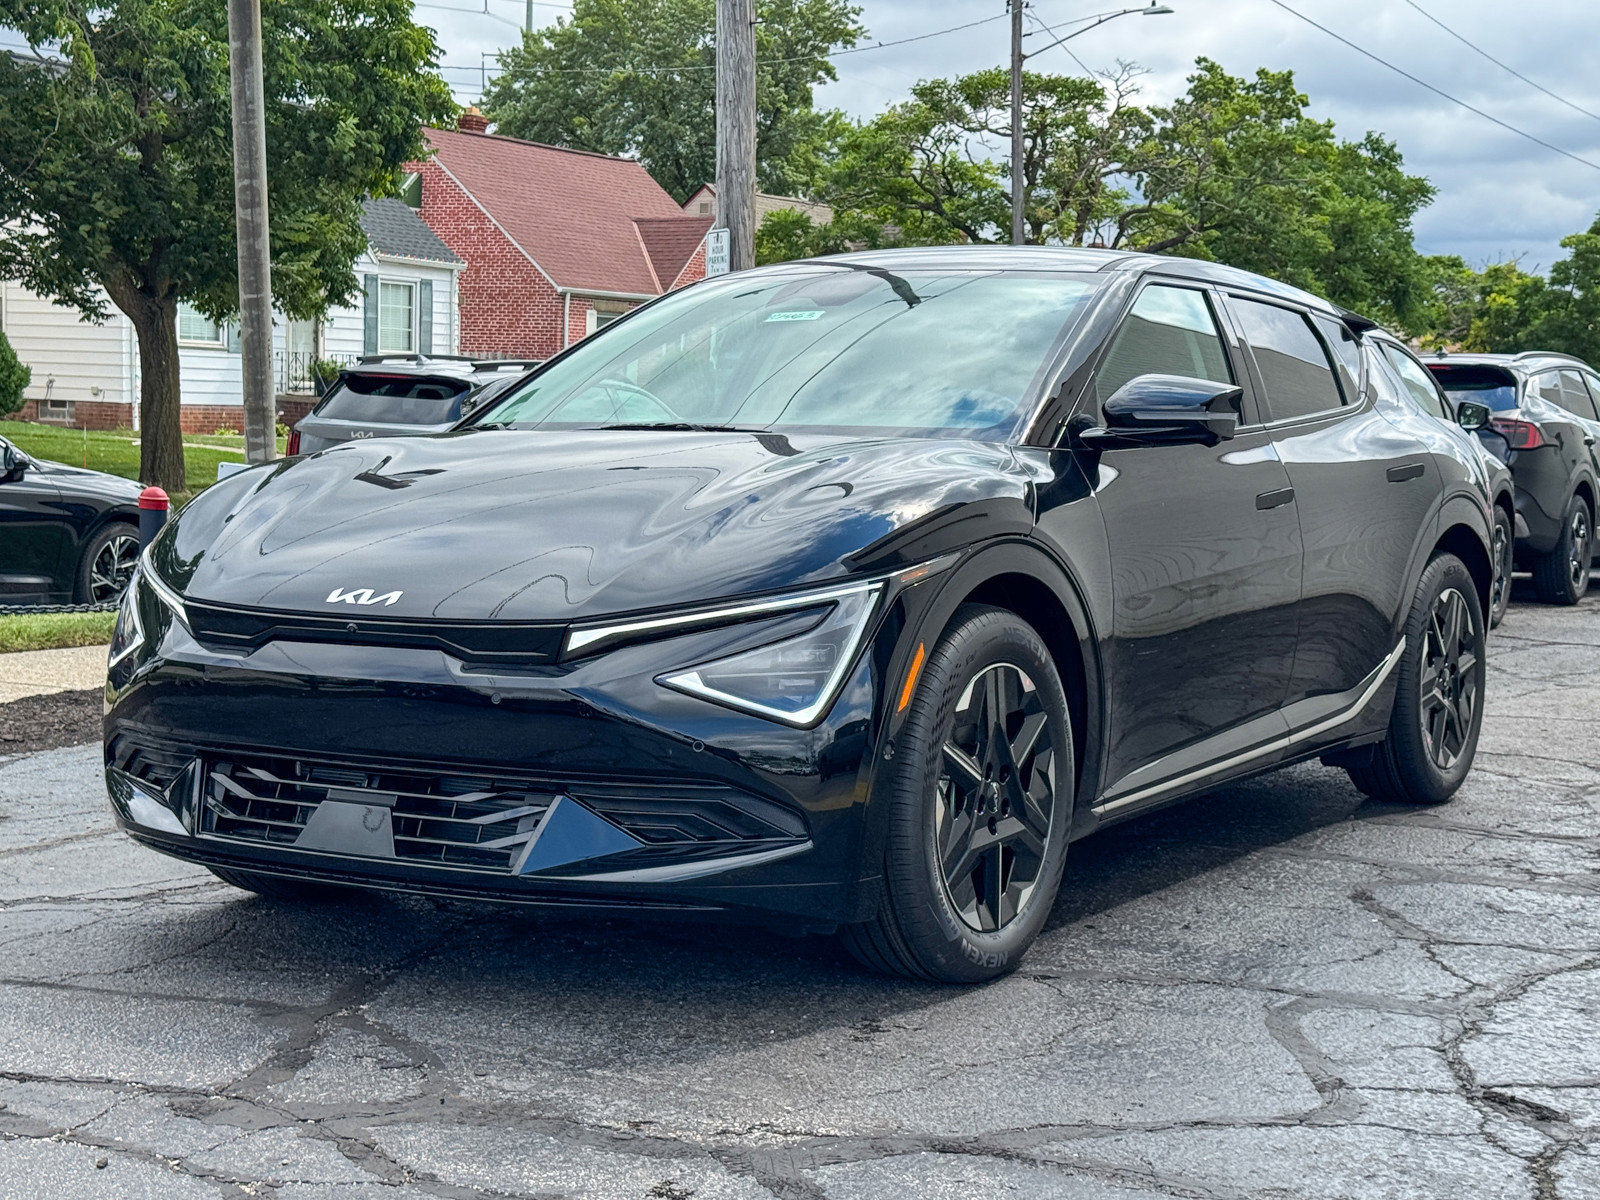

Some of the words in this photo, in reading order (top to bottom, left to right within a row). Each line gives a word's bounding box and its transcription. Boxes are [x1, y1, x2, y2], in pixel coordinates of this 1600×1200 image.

[708, 255, 727, 264] PARKING
[712, 245, 724, 255] HOUR
[326, 587, 404, 606] KIA
[1003, 626, 1046, 664] NEXEN
[961, 938, 1009, 968] NEXEN
